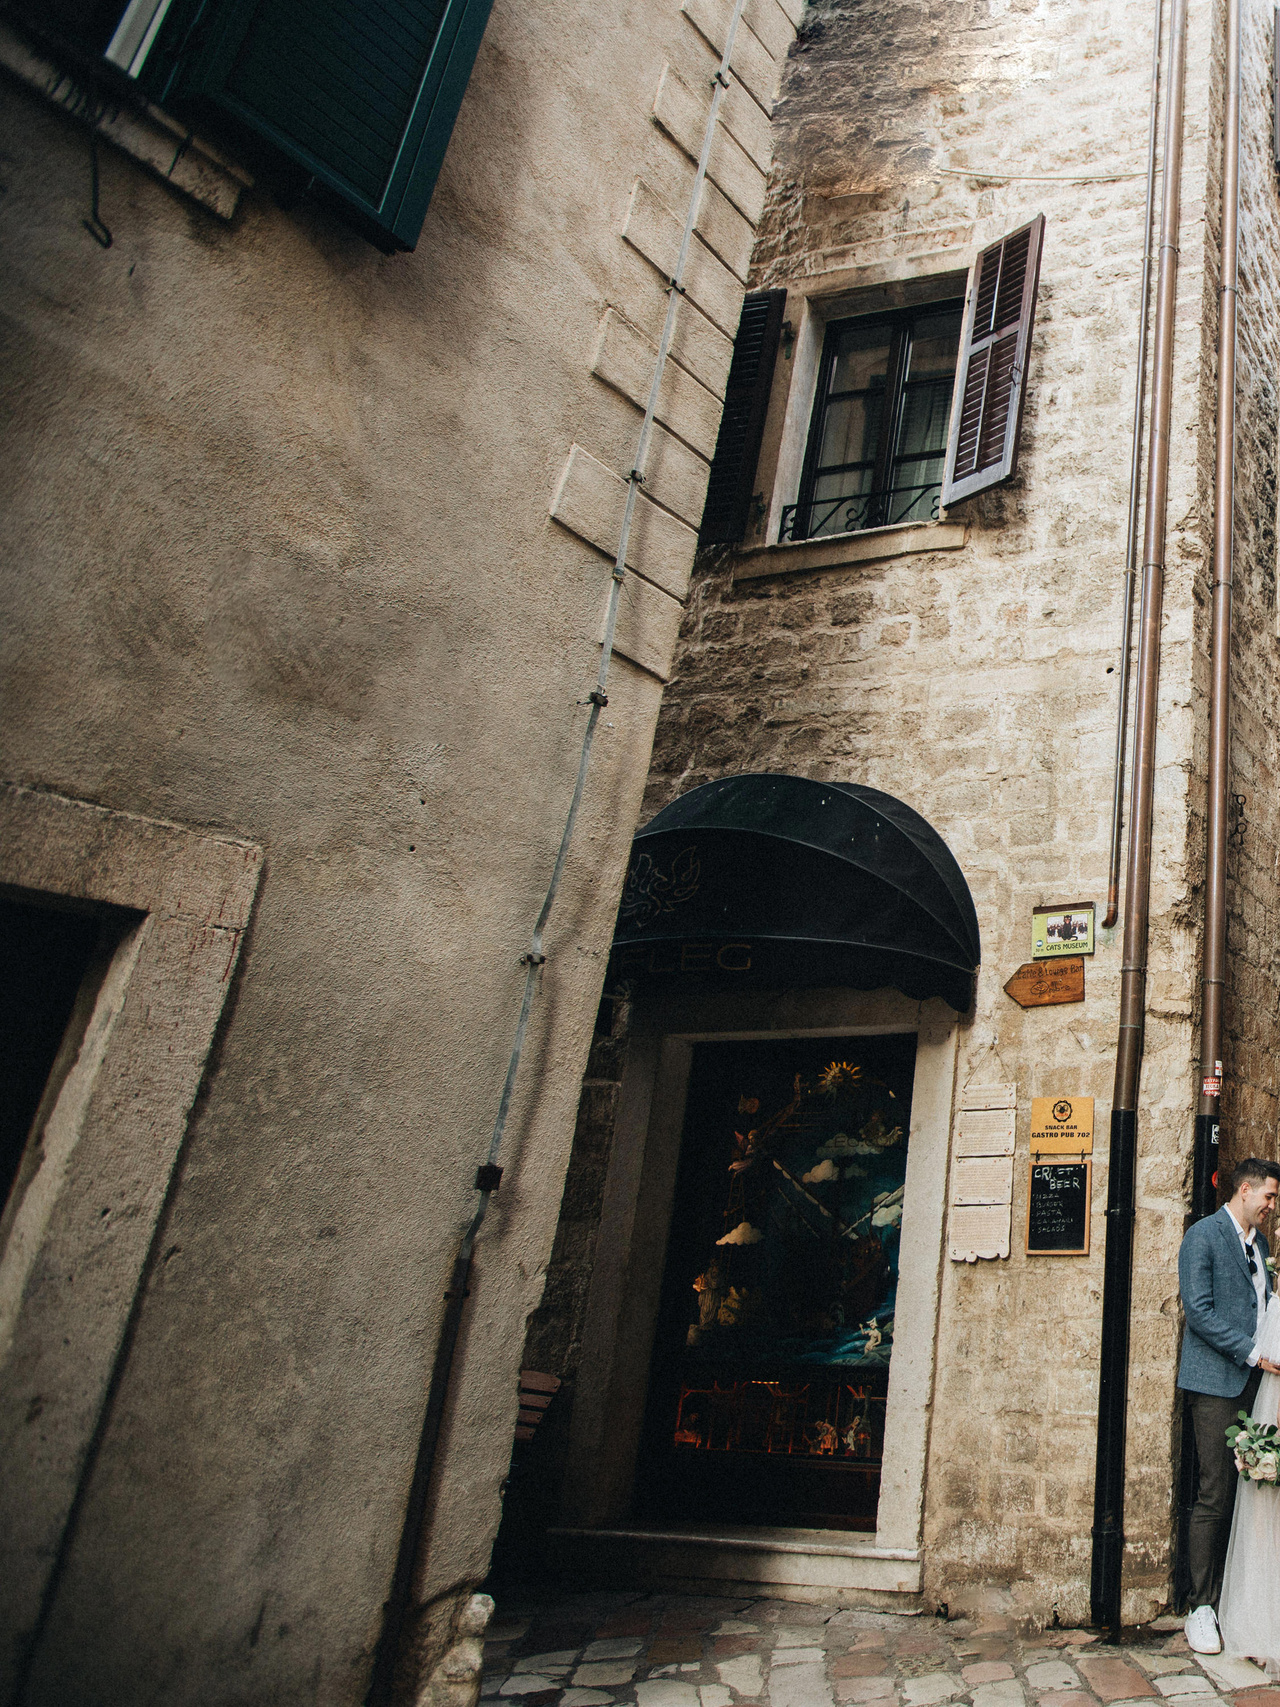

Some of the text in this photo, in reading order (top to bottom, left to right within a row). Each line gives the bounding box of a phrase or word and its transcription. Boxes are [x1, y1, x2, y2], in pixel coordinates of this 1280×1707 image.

[1046, 941, 1088, 952] CATS MUSEUM
[1038, 966, 1044, 978] &
[1045, 966, 1069, 977] Lounge
[1070, 964, 1084, 974] Bar
[1050, 1177, 1080, 1190] BEER
